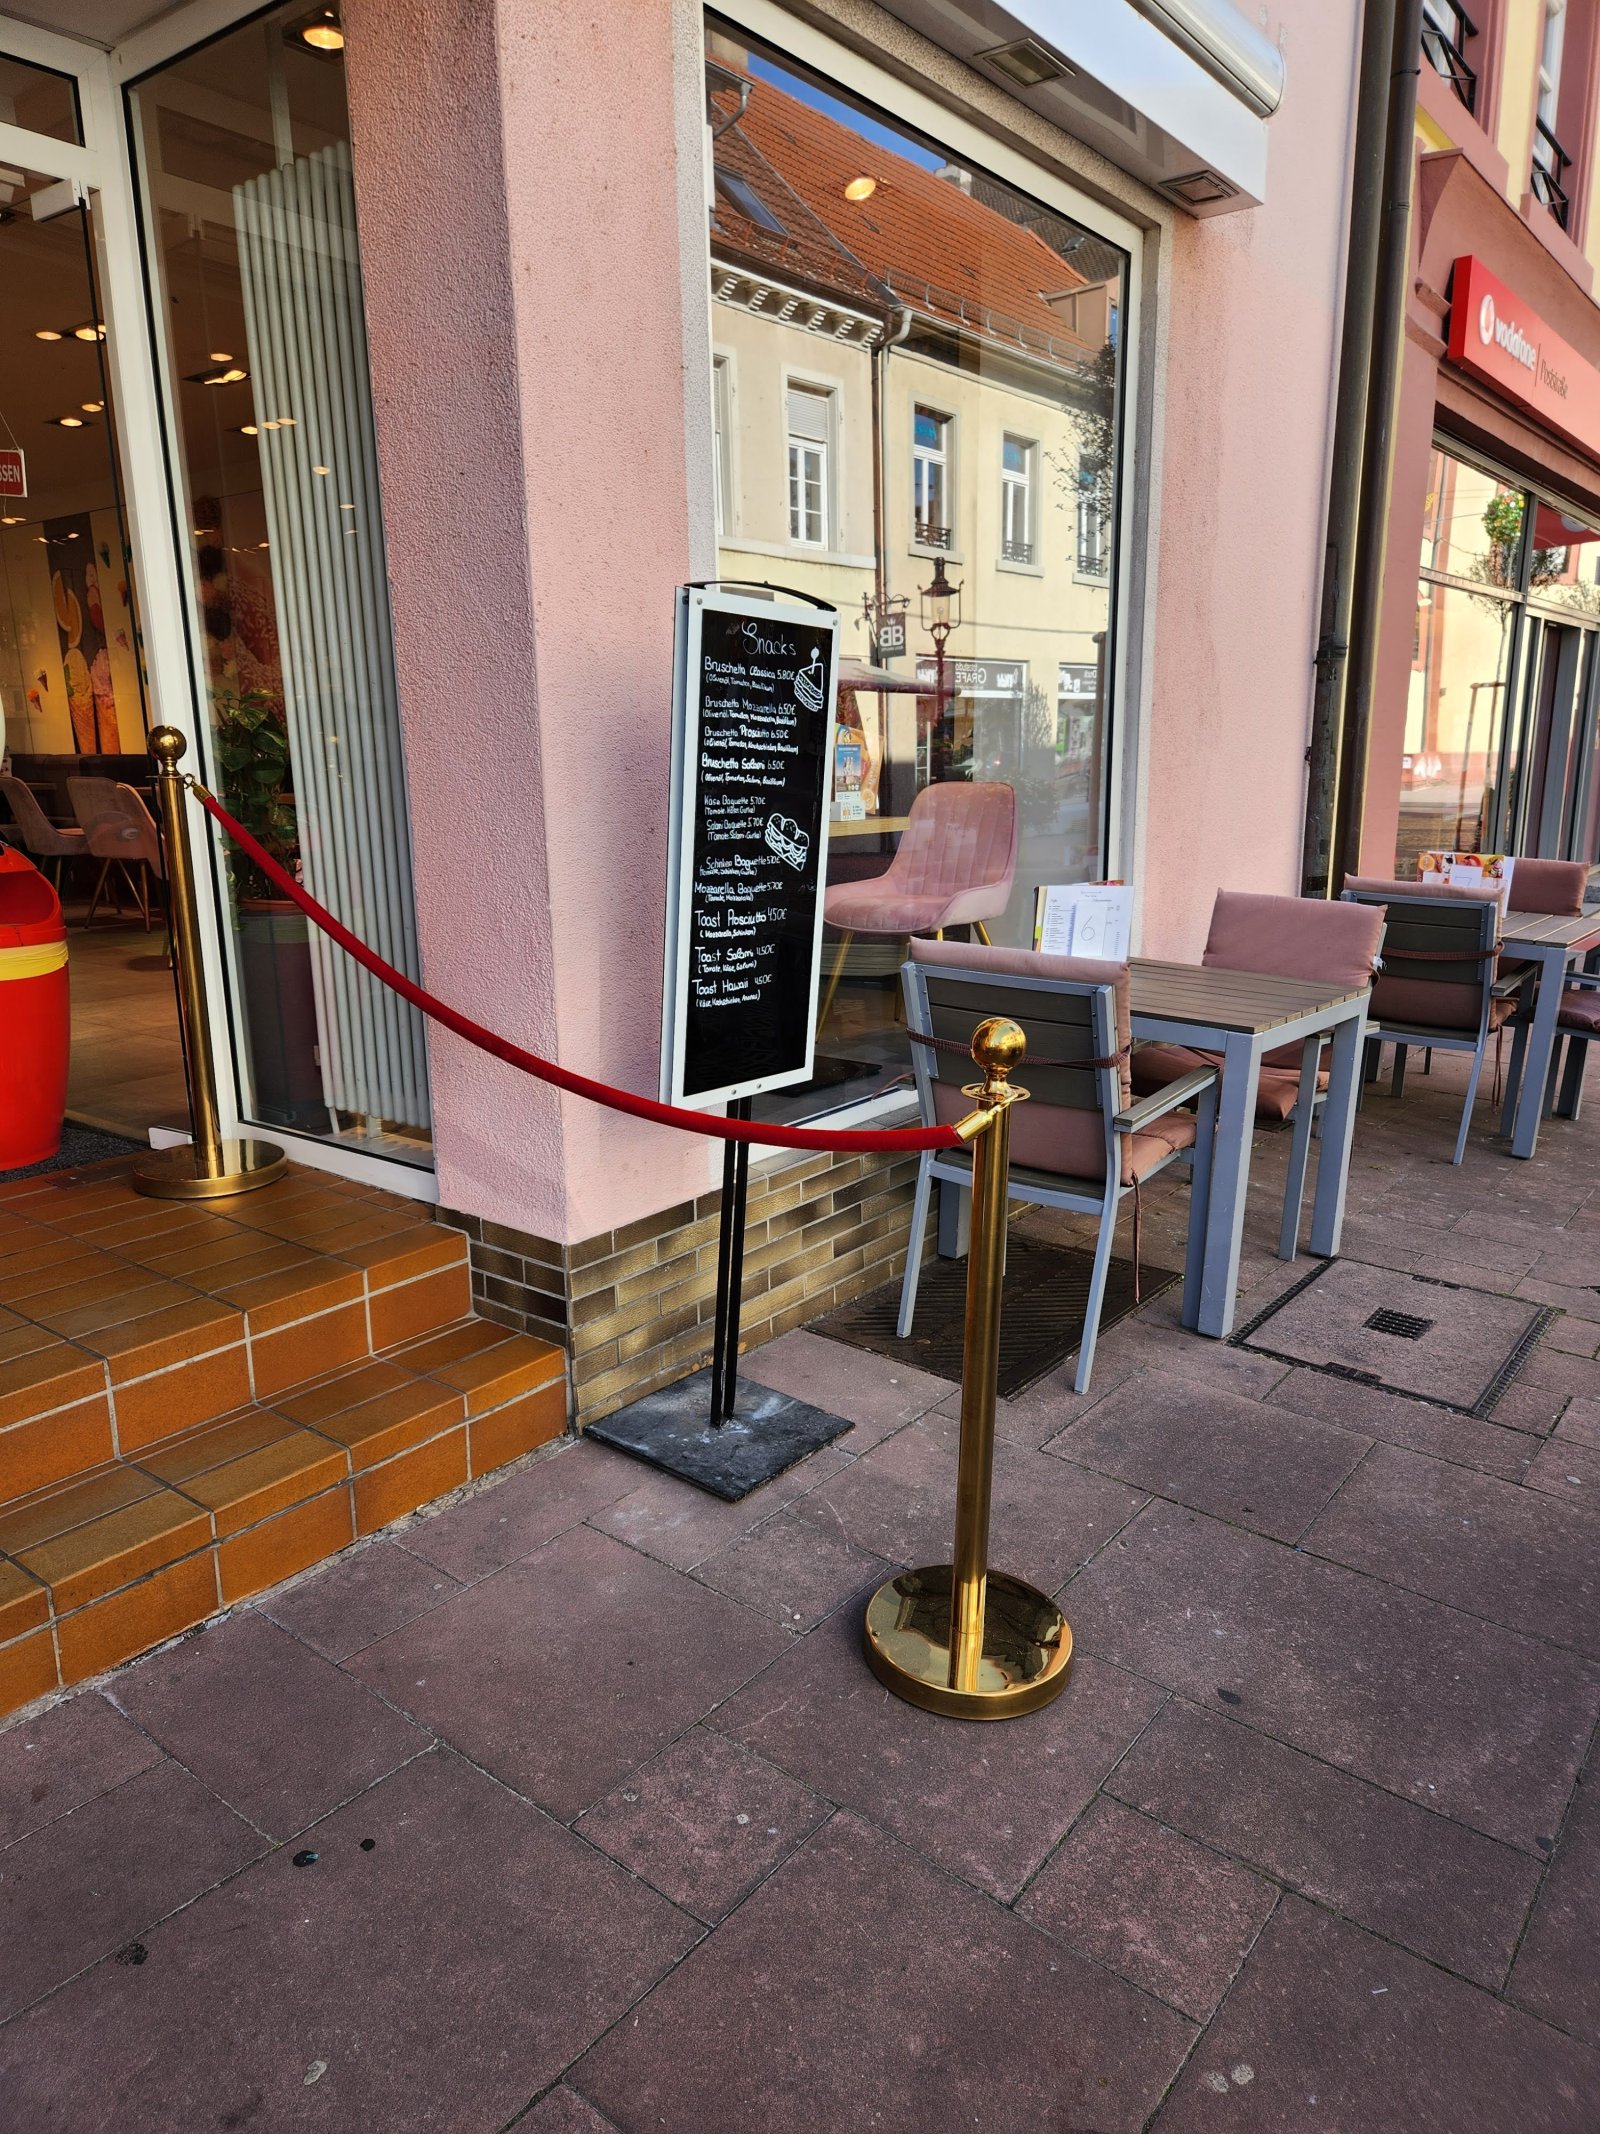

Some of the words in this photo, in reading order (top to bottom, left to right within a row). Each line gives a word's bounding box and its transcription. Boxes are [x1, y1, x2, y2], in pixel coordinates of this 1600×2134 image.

[1495, 317, 1536, 371] vodafone
[1540, 358, 1568, 400] Poststraße
[742, 621, 797, 656] Snacks
[705, 656, 746, 675] Bruschetta
[705, 695, 740, 708] Bruschetta
[742, 698, 777, 714] Mozzarella
[704, 726, 738, 737] Bruschetta
[701, 752, 739, 770] Bruschetta
[741, 758, 766, 770] Salami
[722, 794, 749, 808] Baguette
[706, 856, 733, 870] Schinken
[734, 854, 766, 871] Baguette
[694, 881, 735, 895] Mozzarella
[737, 882, 767, 895] Baguette
[694, 910, 721, 927] Toast
[727, 908, 767, 927] Prosciutto
[695, 946, 721, 963] Toast
[726, 947, 754, 961] Salami
[692, 979, 717, 995] Toast
[722, 978, 749, 993] Hawaii
